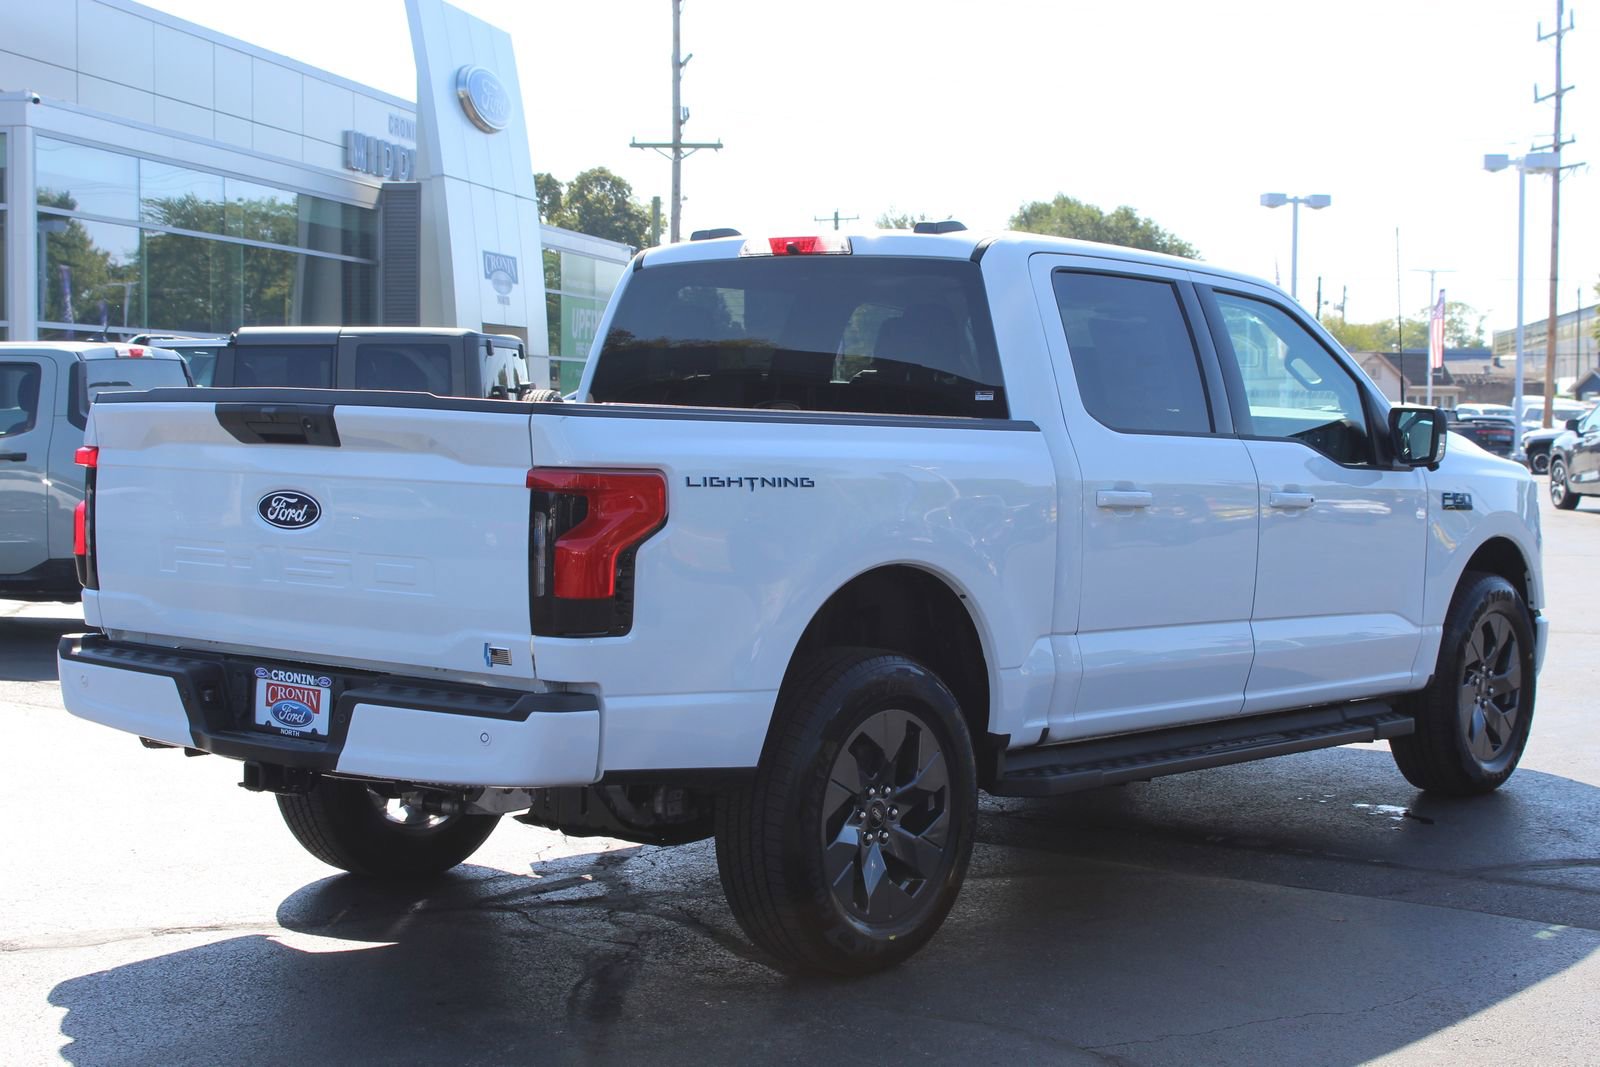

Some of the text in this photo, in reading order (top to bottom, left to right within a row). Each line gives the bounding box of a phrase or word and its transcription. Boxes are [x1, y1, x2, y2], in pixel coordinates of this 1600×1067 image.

[485, 254, 516, 282] CRONIN
[685, 475, 815, 492] LIGHTNING
[267, 495, 308, 522] Ford
[271, 669, 314, 686] CRONIN
[267, 685, 319, 710] CRONIN
[278, 703, 306, 723] Ford
[280, 728, 300, 737] NORTH
